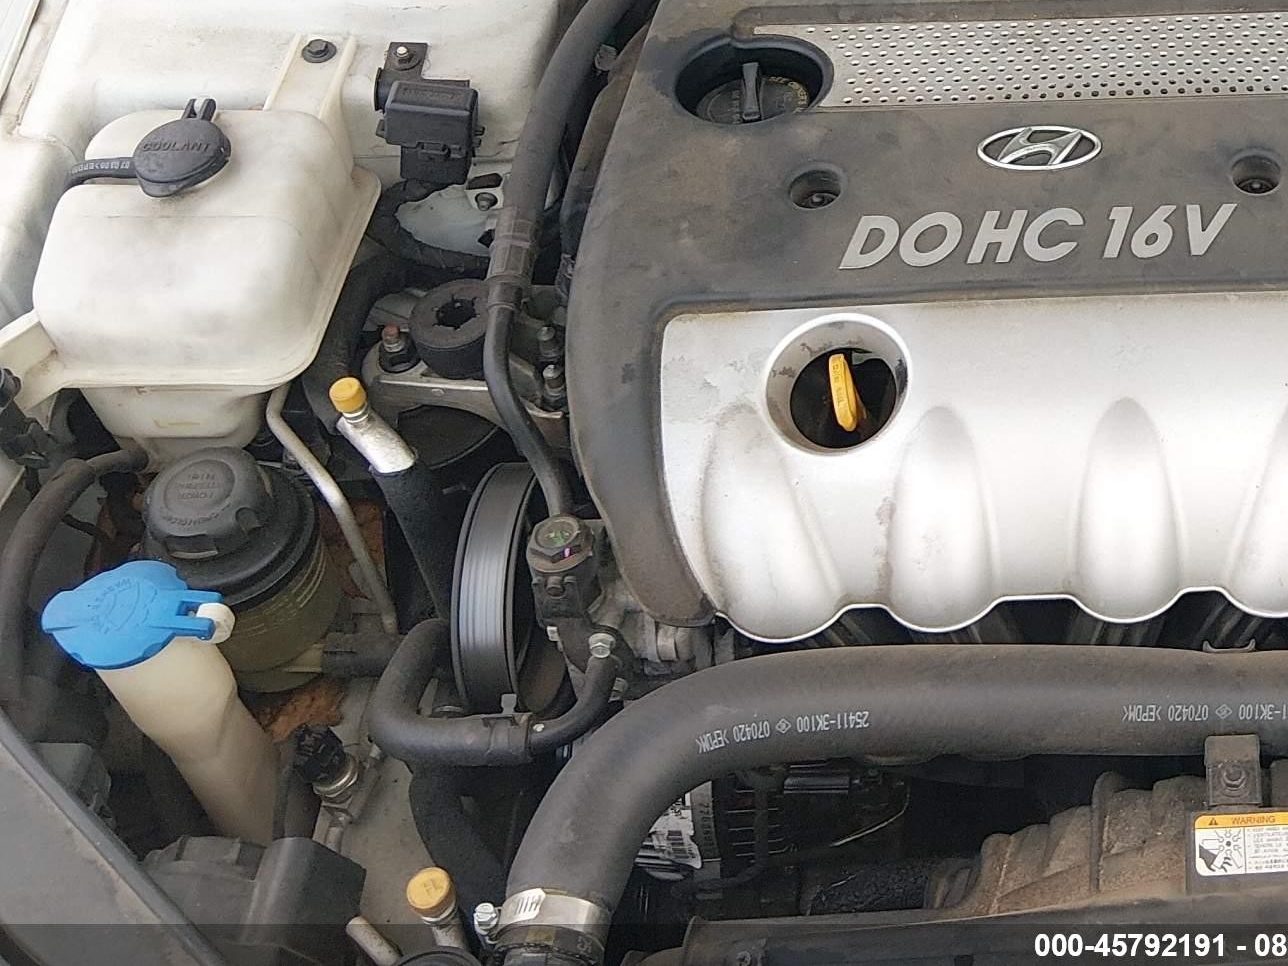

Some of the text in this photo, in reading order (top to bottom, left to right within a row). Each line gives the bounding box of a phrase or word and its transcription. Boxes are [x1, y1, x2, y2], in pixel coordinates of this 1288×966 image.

[142, 138, 212, 153] COOLANT
[838, 204, 1238, 269] DOHC 16V
[796, 710, 870, 732] 25411-3K100
[1167, 704, 1209, 721] 070420
[732, 720, 771, 743] 070420
[1231, 815, 1275, 824] WARNING
